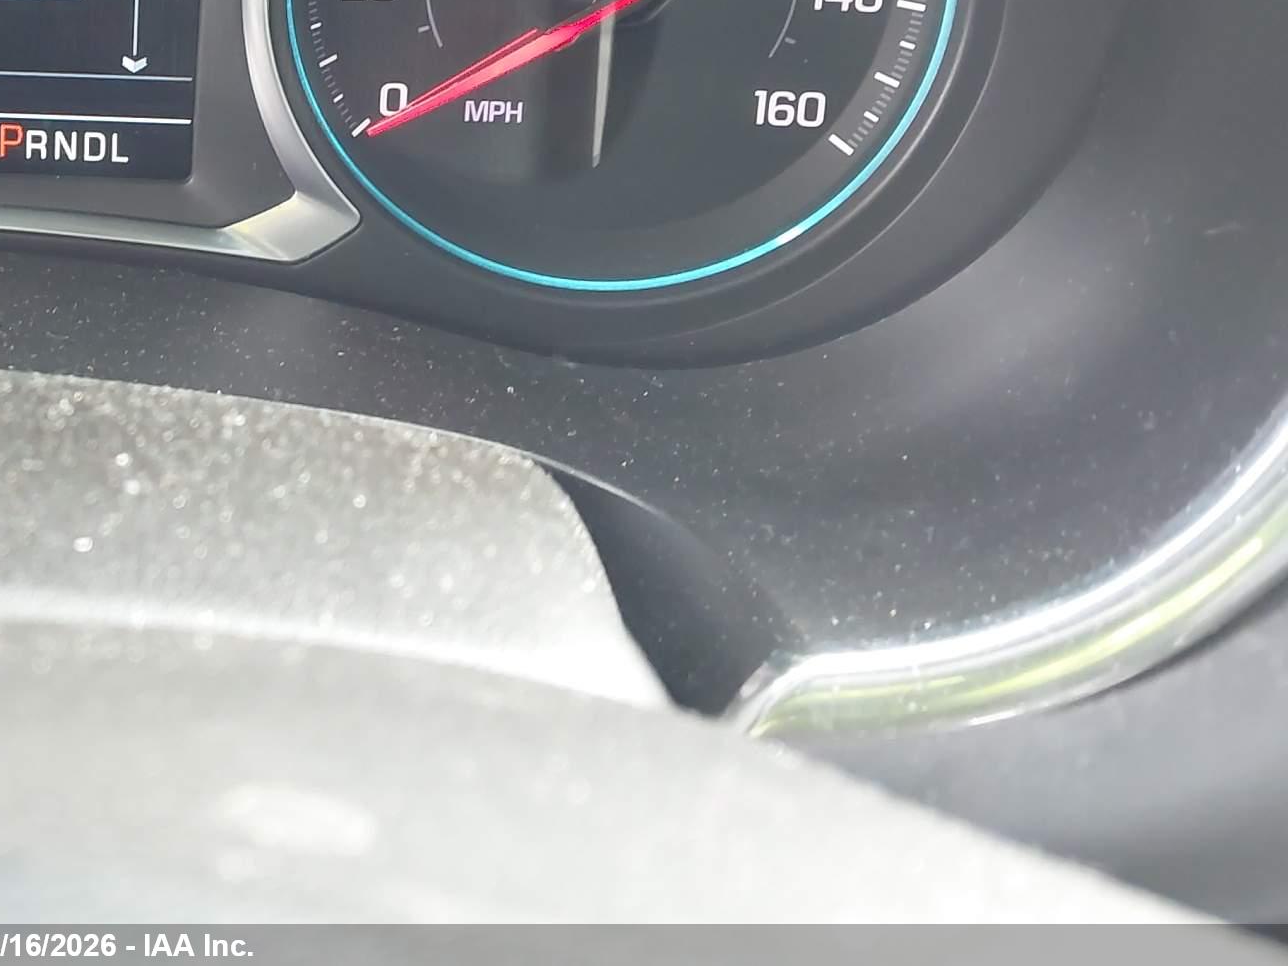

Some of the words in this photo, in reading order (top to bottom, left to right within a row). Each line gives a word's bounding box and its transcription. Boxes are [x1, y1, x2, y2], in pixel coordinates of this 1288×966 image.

[379, 83, 409, 117] 0
[463, 100, 523, 124] MPH
[753, 89, 826, 127] 160
